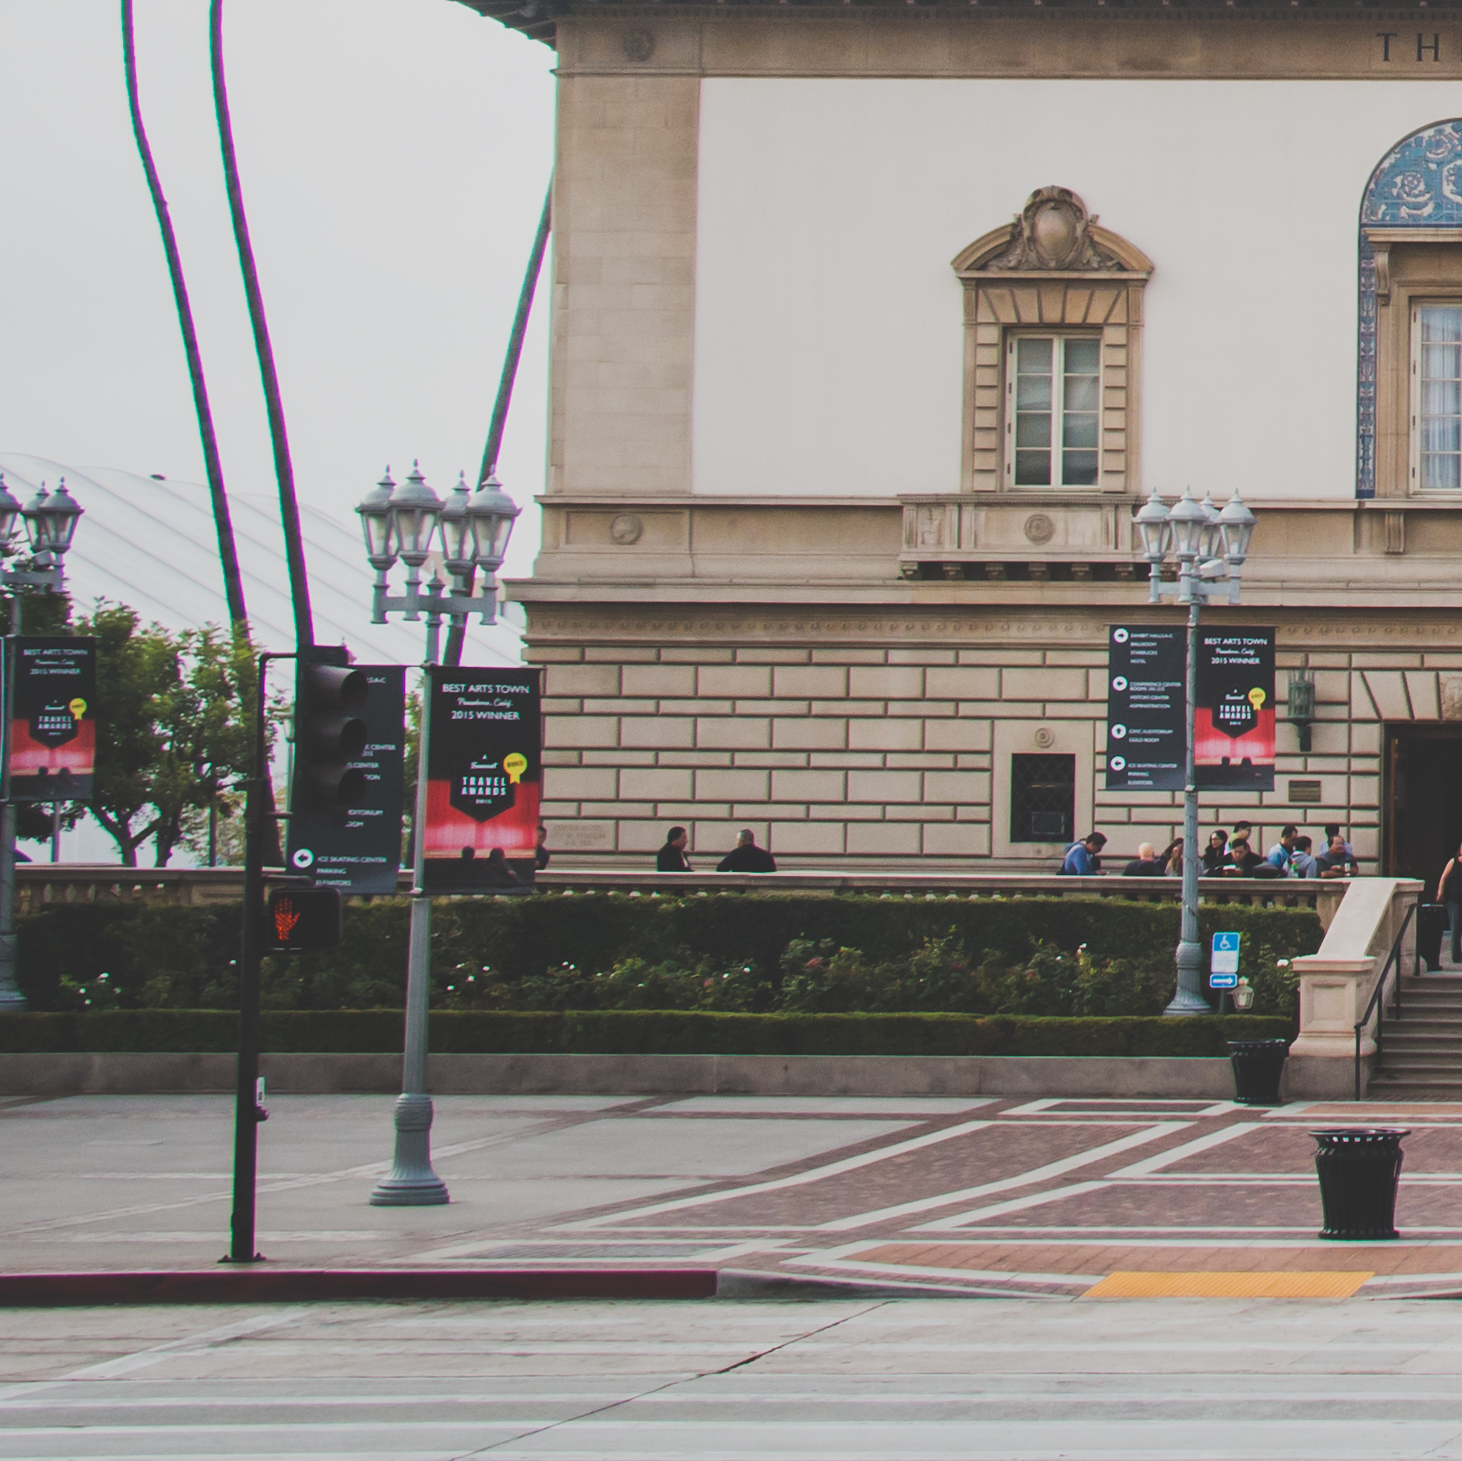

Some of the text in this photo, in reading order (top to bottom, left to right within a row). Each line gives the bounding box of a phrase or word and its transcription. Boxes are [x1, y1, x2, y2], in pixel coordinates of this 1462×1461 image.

[442, 684, 530, 694] BEST ARTS TOWN
[1220, 704, 1251, 712] TRAVEL
[451, 711, 520, 720] 2015 WINNER
[462, 777, 506, 786] TRAVEL
[461, 787, 506, 795] AWARDS
